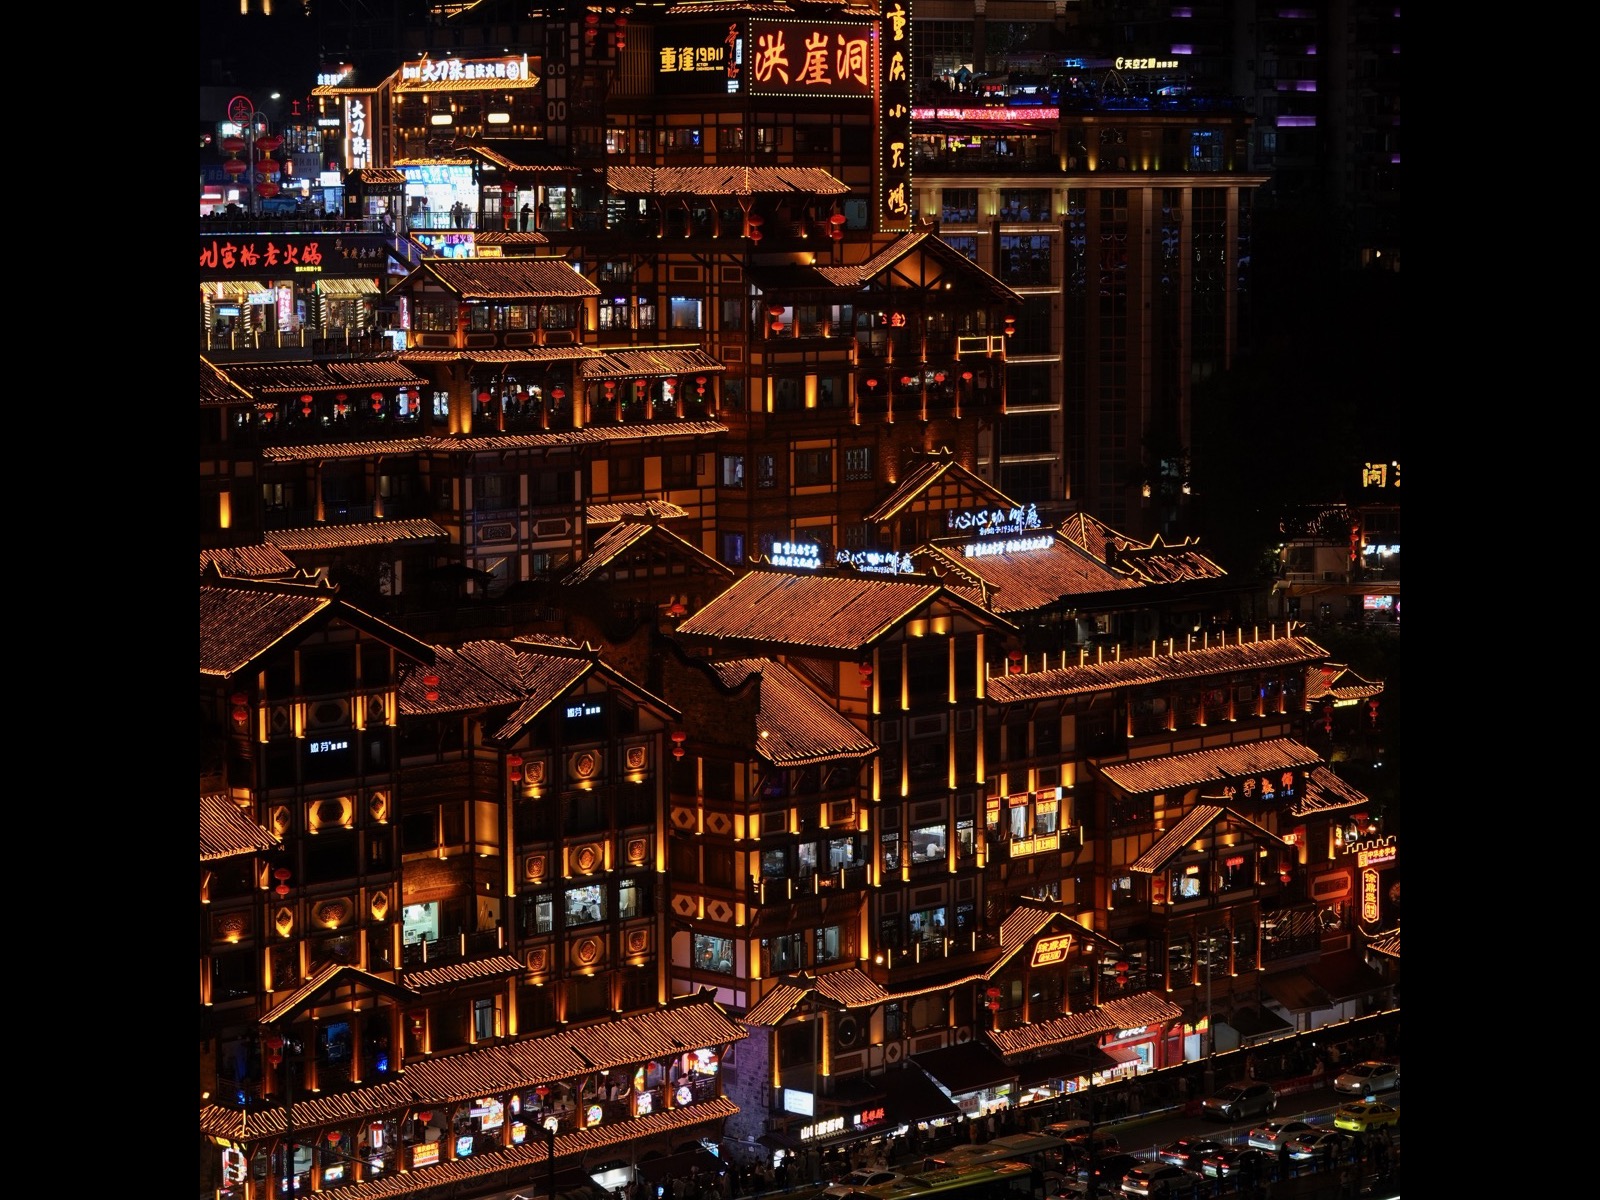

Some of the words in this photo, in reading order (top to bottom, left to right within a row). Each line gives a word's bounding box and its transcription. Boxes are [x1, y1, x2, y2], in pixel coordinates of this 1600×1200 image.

[755, 31, 868, 86] 洪崖洞
[200, 240, 323, 269] 九宫格老火锅
